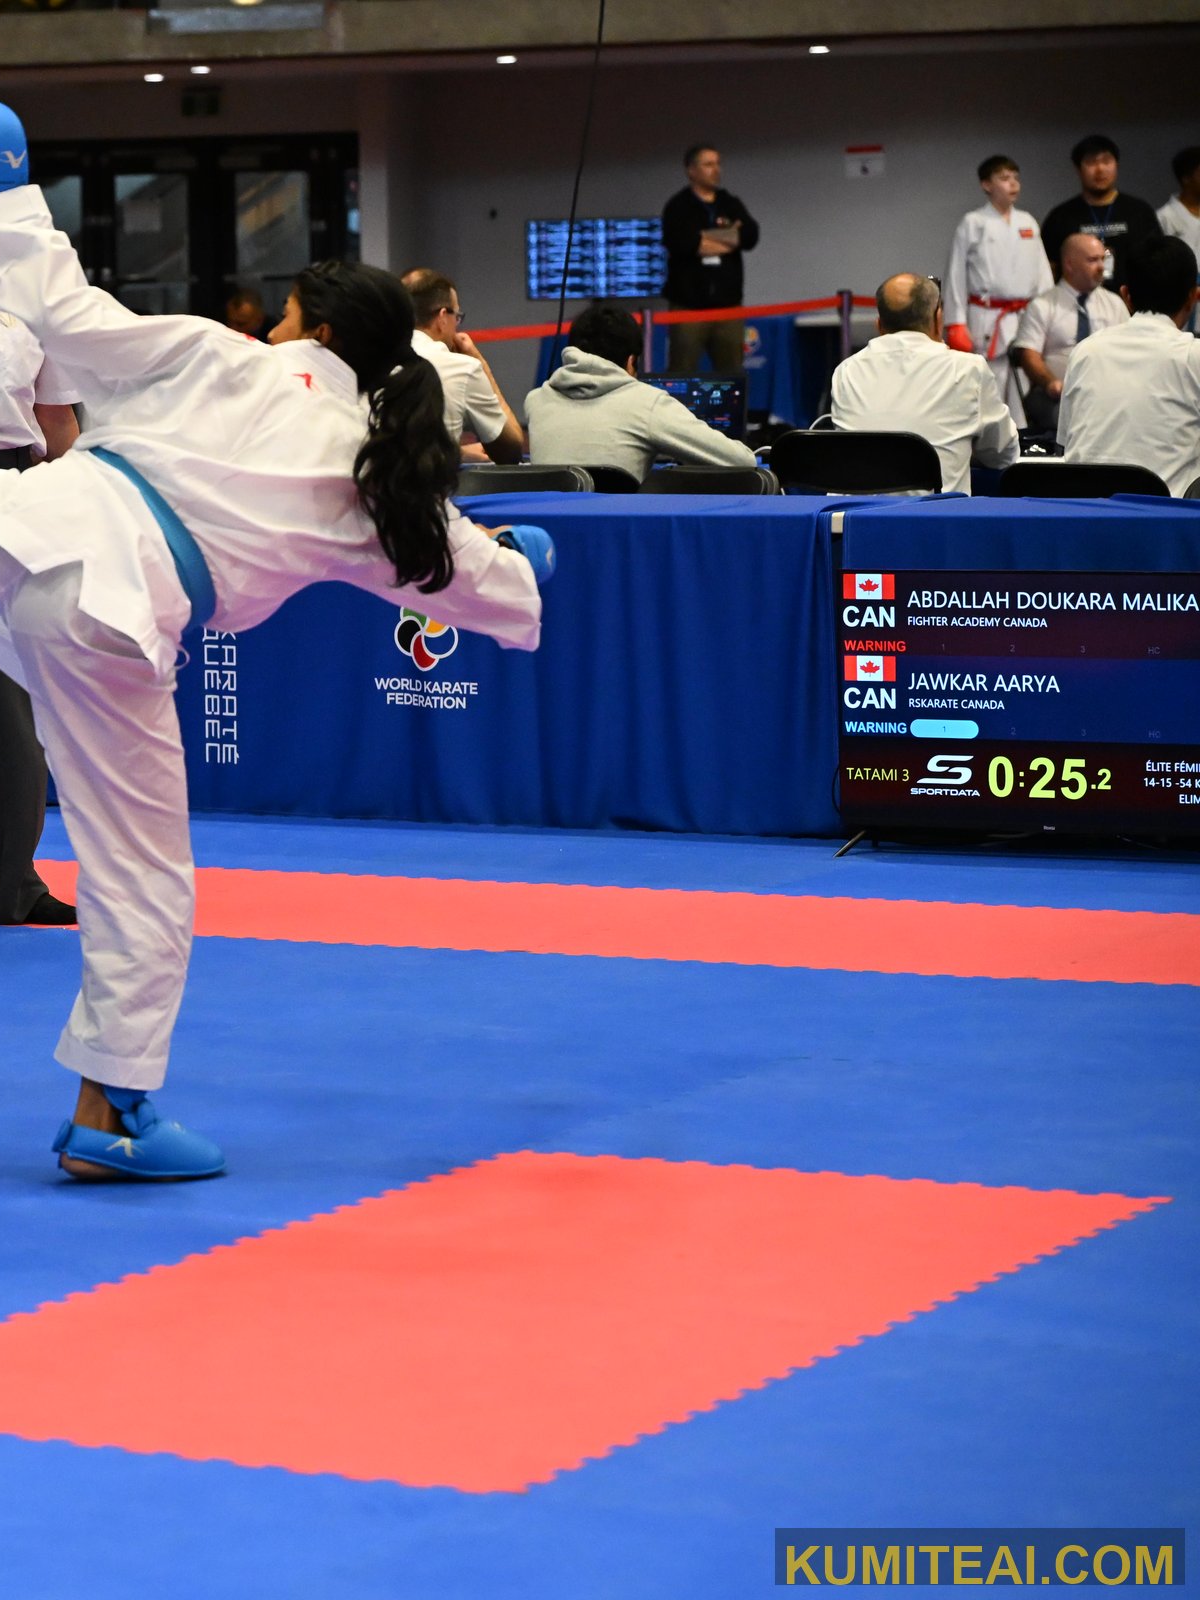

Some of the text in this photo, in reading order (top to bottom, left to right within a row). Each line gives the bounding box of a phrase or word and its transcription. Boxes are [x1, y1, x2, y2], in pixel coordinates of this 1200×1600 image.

[907, 591, 1200, 611] ABDALLAH DOUKARA MALIKA
[842, 605, 896, 628] CAN
[907, 616, 1048, 628] FIGHTER ACADEMY CANADA
[844, 640, 907, 652] WARNING
[374, 677, 479, 695] WORLD KARATE
[908, 673, 1061, 693] JAWKAR AARYA
[386, 692, 467, 710] FEDERATION
[843, 687, 897, 710] CAN
[908, 698, 1006, 710] RSKARATE CANADA
[844, 721, 907, 734] WARNING
[942, 725, 948, 733] 1
[1145, 759, 1172, 772] ÉLITE
[846, 767, 910, 782] TATAMI 3
[1143, 777, 1172, 788] 14-15
[1175, 778, 1192, 788] -54
[910, 787, 981, 797] SPORTDATA
